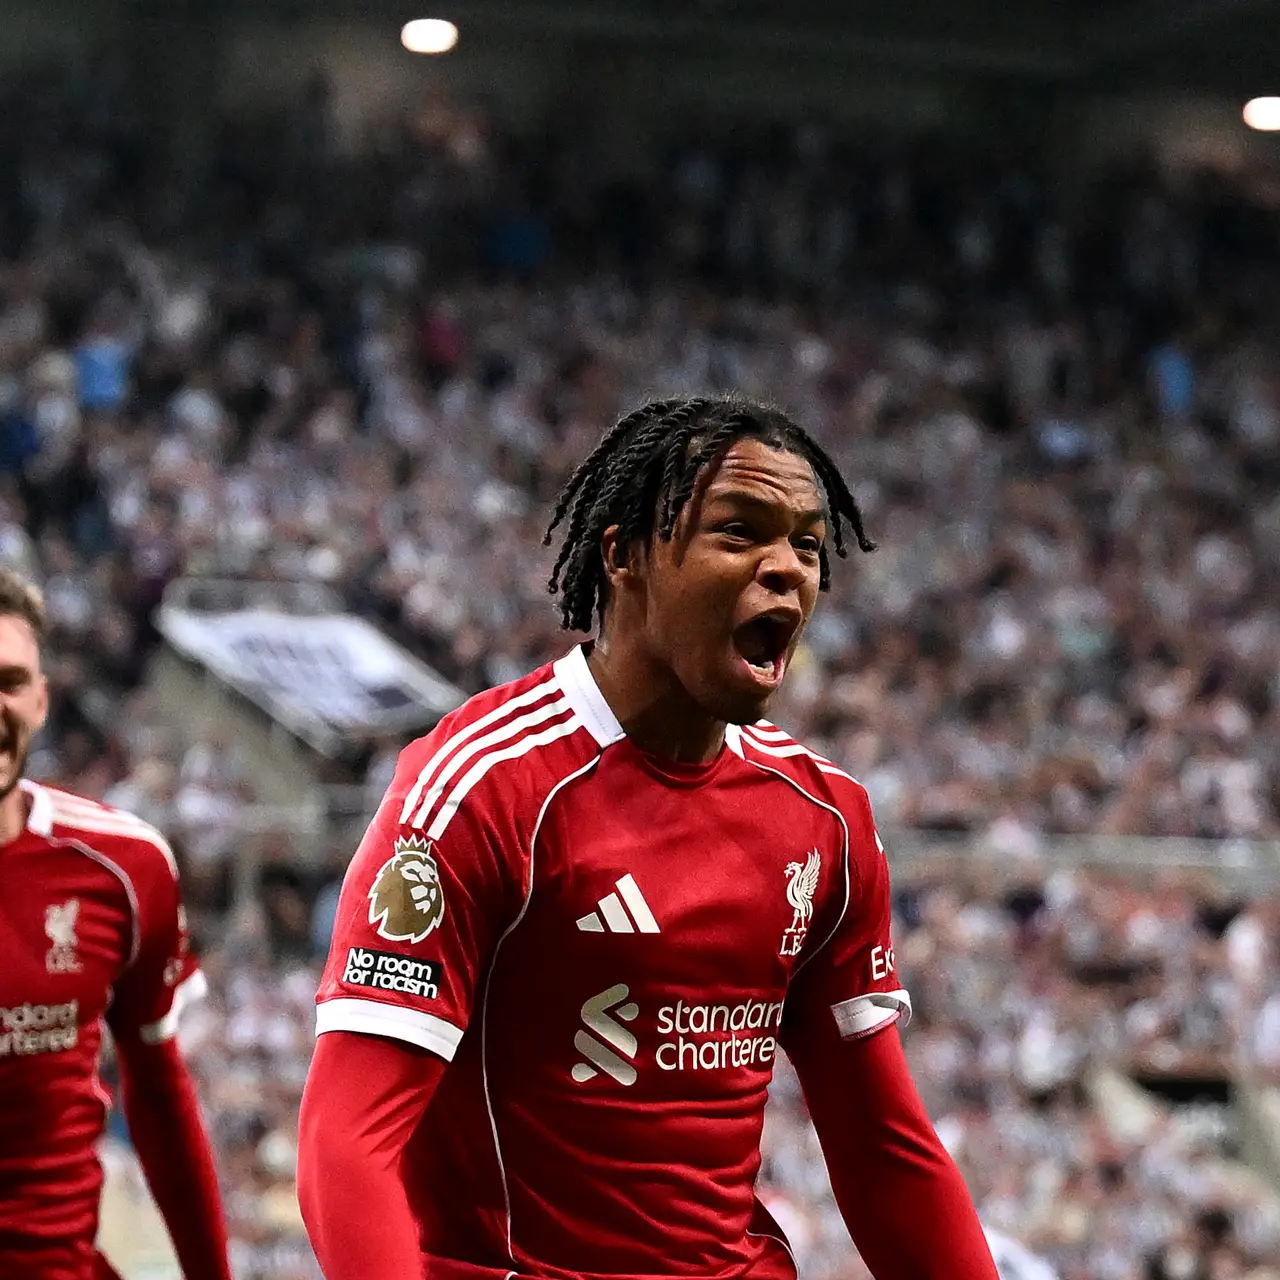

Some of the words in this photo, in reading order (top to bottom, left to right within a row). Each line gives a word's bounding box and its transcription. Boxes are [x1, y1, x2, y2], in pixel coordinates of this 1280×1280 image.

[342, 964, 371, 985] for
[371, 971, 438, 999] racism
[346, 947, 375, 968] No
[376, 955, 432, 981] room
[655, 1032, 776, 1070] chartere
